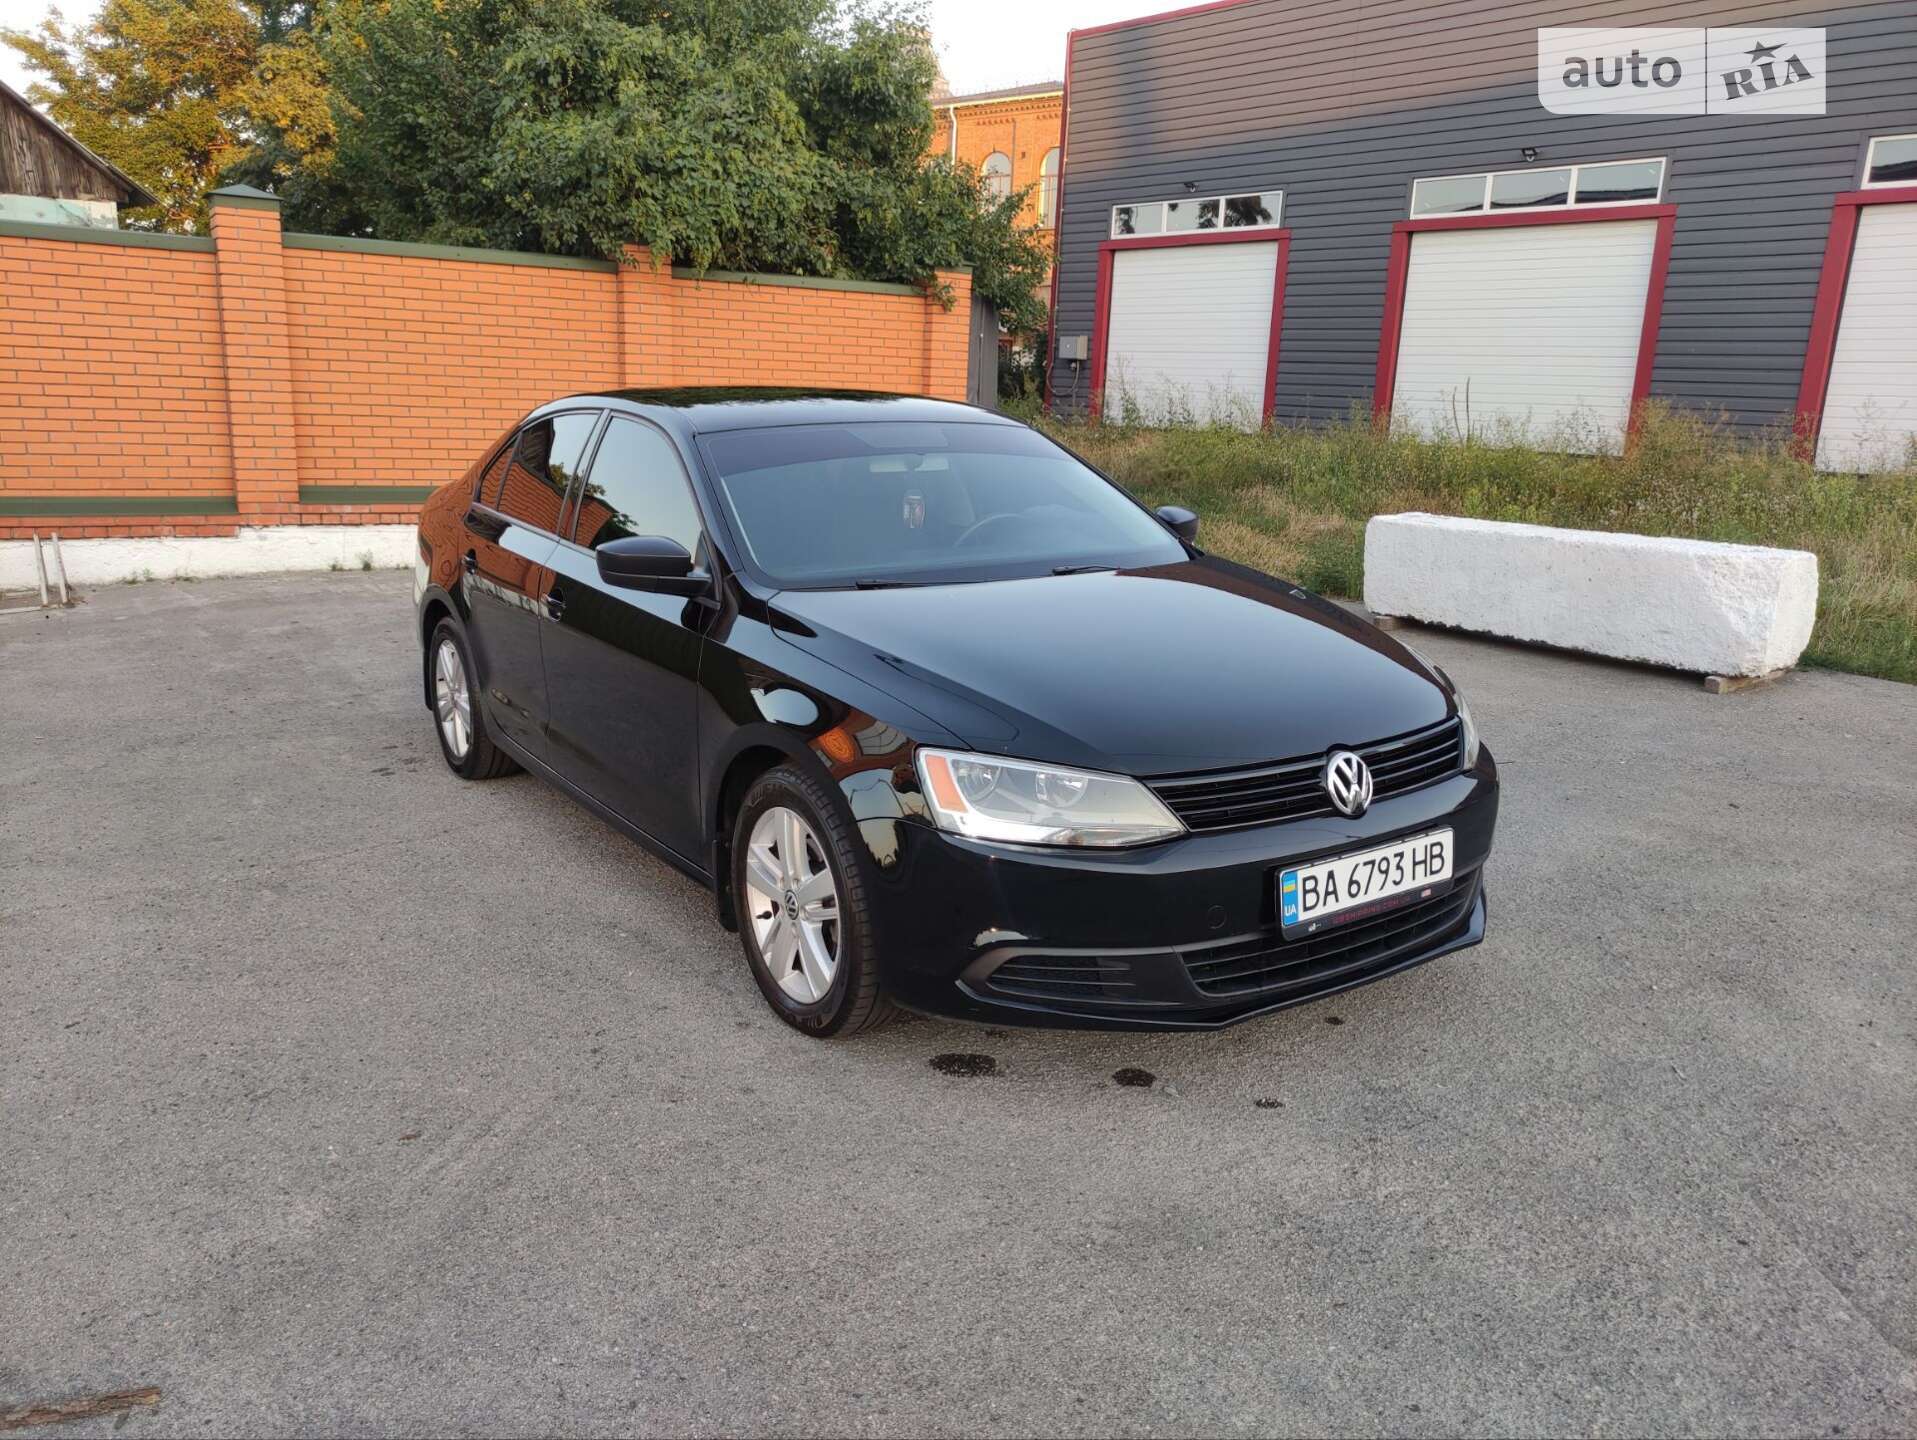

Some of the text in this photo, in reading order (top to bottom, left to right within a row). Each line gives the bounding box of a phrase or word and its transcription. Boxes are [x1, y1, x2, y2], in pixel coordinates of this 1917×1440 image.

[1302, 869, 1340, 913] BA
[1347, 851, 1405, 899] 6793
[1412, 841, 1446, 881] HB
[1284, 906, 1297, 917] UA
